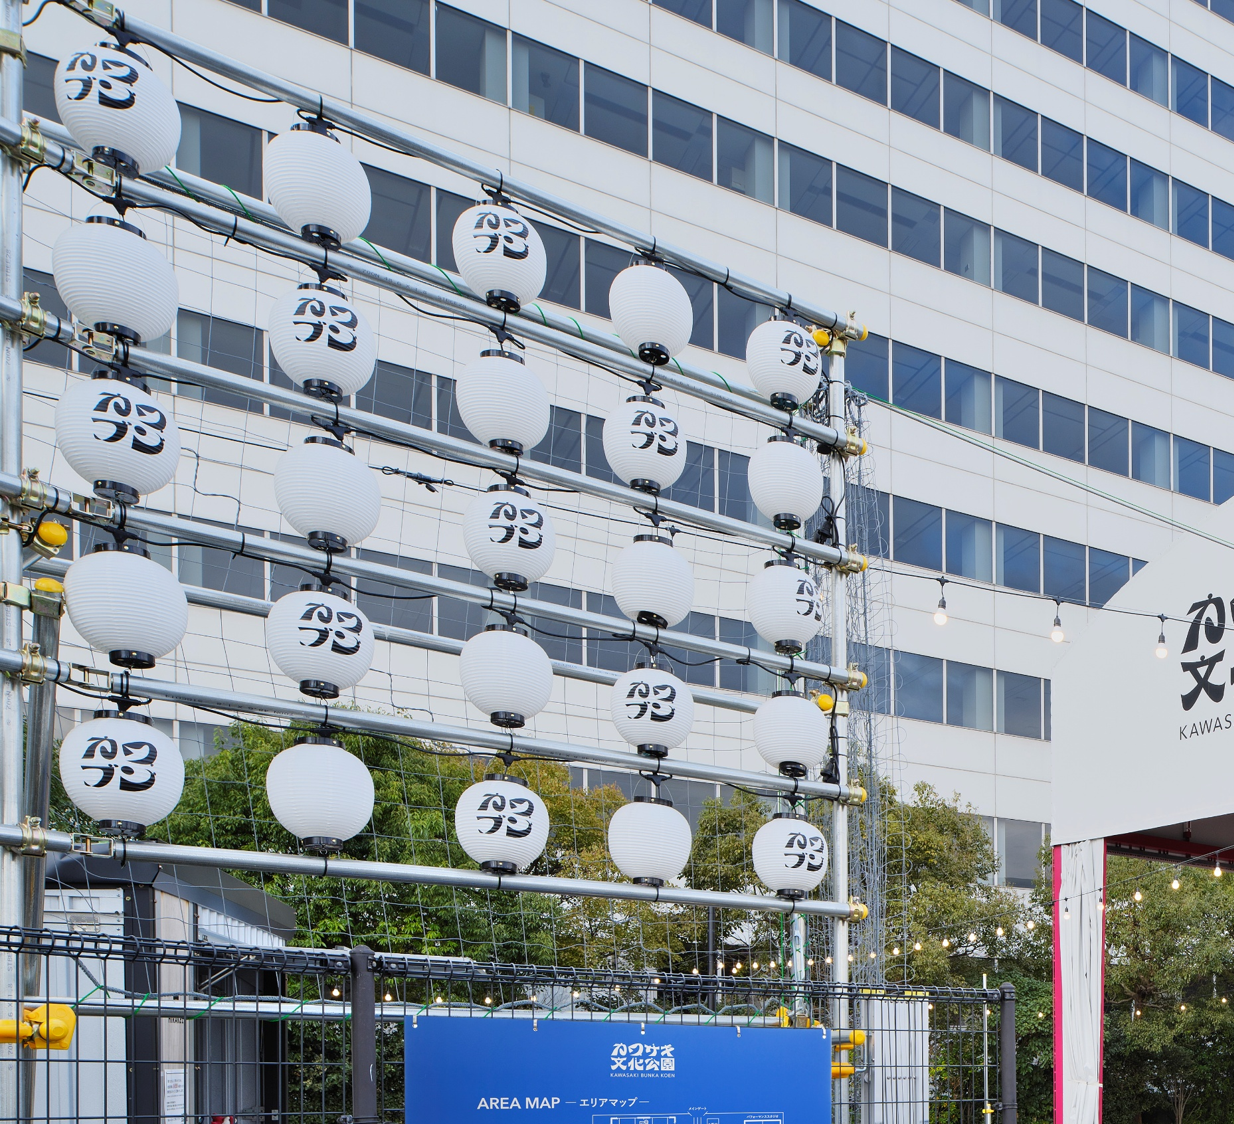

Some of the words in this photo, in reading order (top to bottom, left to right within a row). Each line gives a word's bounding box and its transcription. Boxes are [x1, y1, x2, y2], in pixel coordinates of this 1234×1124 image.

[611, 1043, 674, 1057] カワサキ
[610, 1057, 675, 1071] 文化公園
[477, 1097, 521, 1110] AREA
[526, 1097, 560, 1109] MAP
[579, 1097, 638, 1107] エリアマップ
